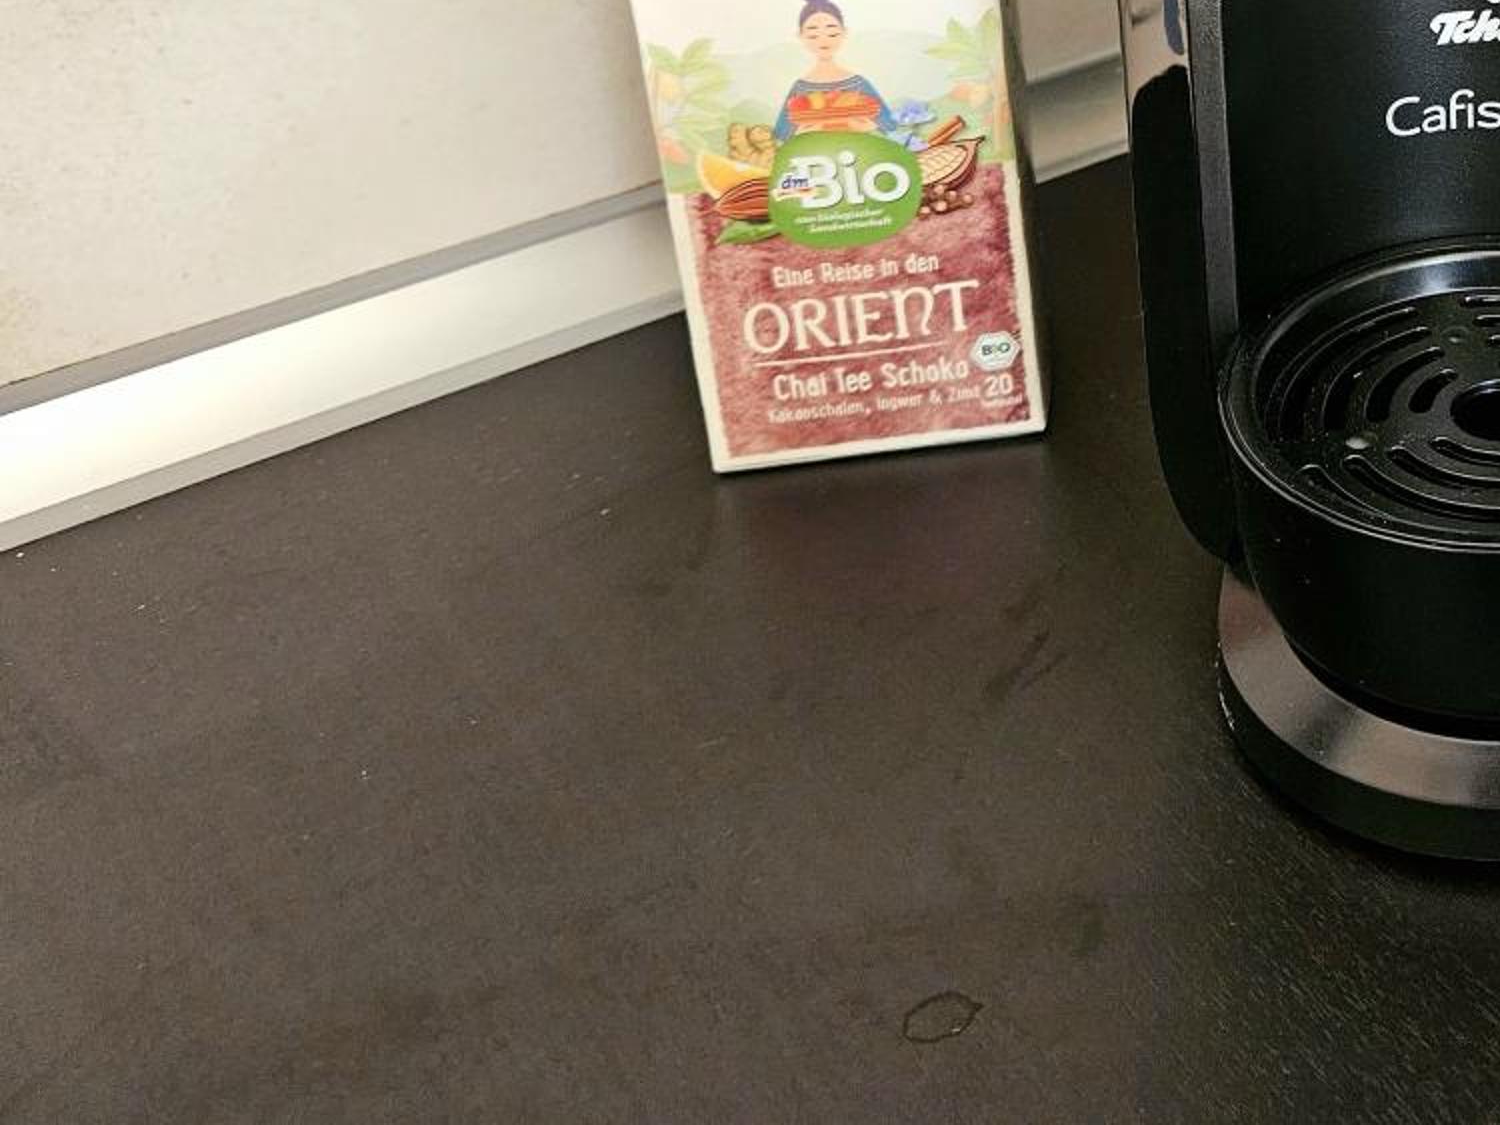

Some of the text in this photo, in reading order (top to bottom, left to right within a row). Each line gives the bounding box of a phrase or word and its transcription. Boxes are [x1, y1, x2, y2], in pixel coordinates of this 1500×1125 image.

[772, 253, 940, 288] Eine Reise in den
[743, 279, 981, 354] ORIENT
[772, 356, 969, 402] Chai Tee Schoko
[982, 372, 1015, 399] 20
